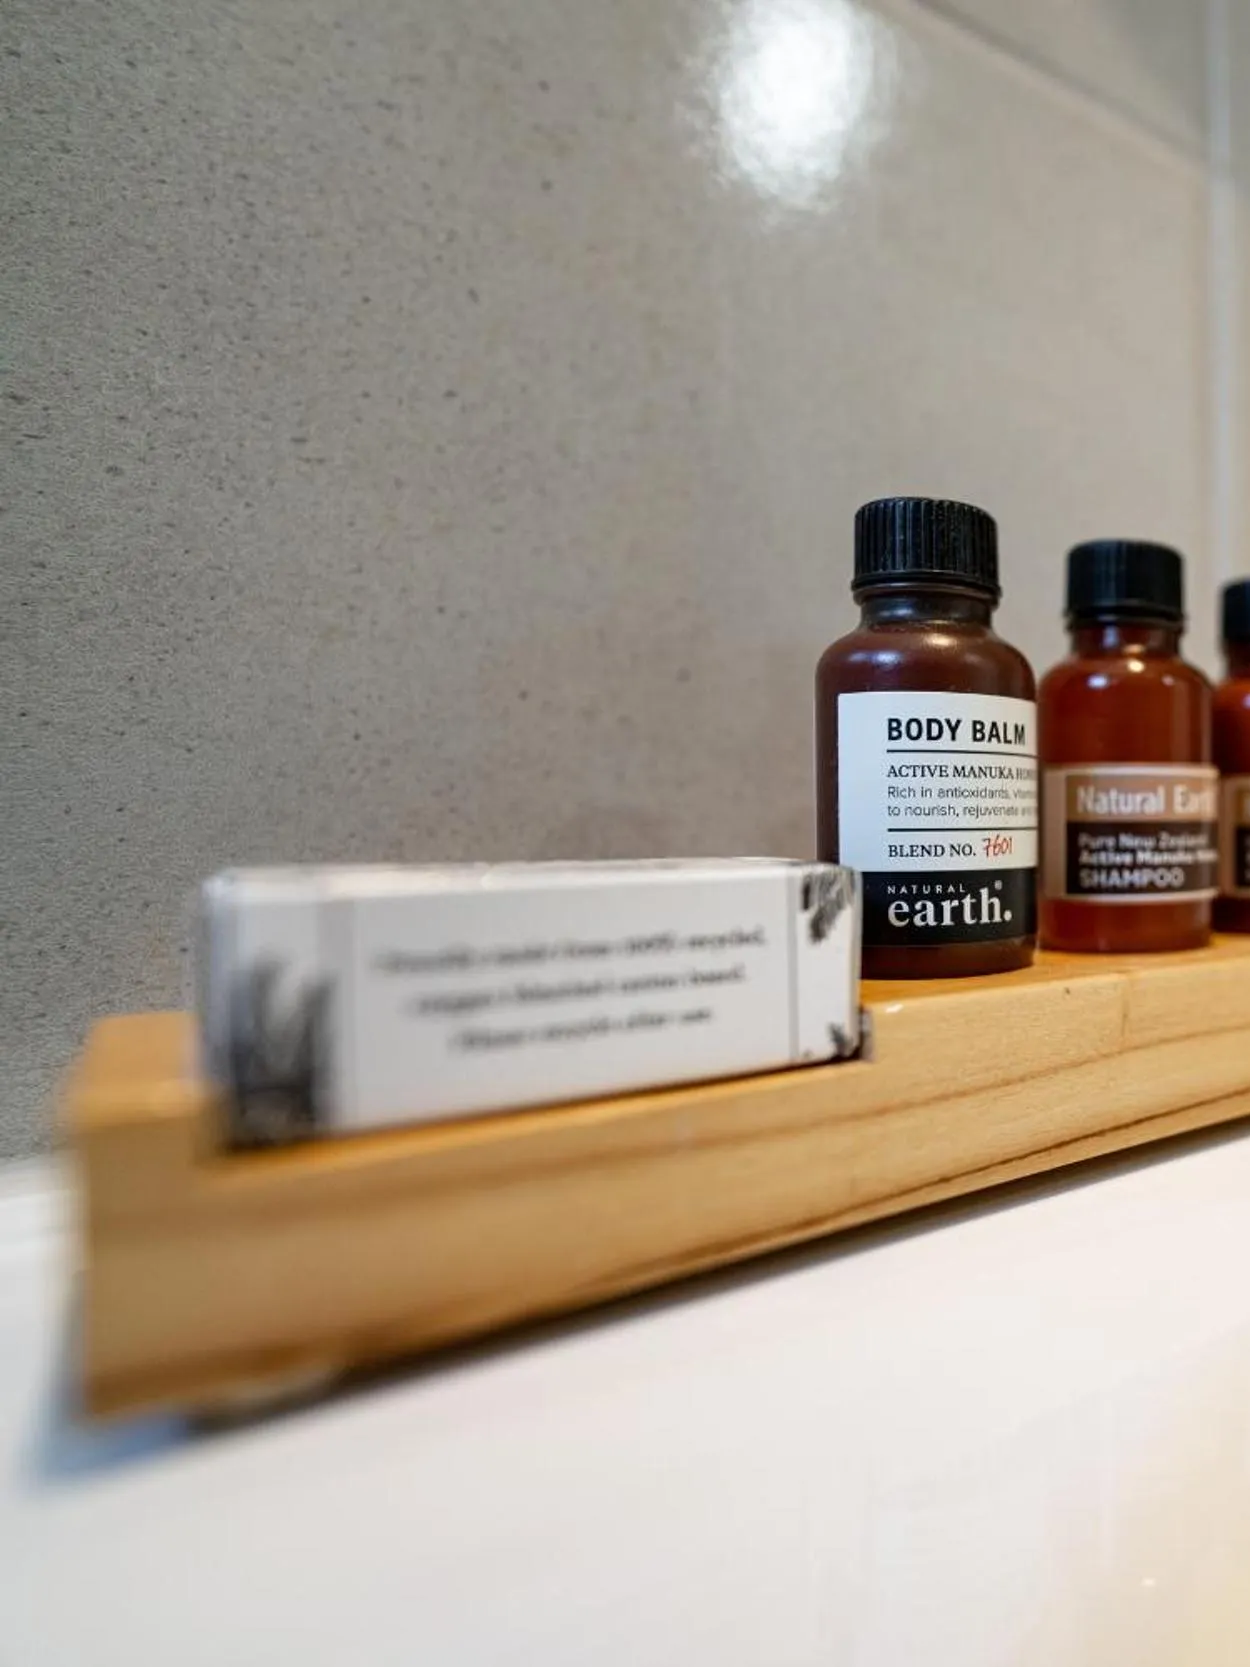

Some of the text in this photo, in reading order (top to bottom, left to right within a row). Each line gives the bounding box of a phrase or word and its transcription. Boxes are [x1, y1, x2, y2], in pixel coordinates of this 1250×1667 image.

[887, 717, 1026, 745] BODY BALM
[887, 764, 949, 778] ACTIVE
[952, 765, 1015, 780] MANUKA
[888, 786, 916, 799] Rich
[921, 786, 933, 798] in
[1077, 784, 1166, 816] Natural
[888, 805, 901, 816] to
[904, 804, 960, 818] nourish,
[888, 844, 946, 858] BLEND
[949, 843, 977, 858] NO.
[1079, 866, 1185, 888] SHAMPOO
[887, 883, 966, 895] NATURAL
